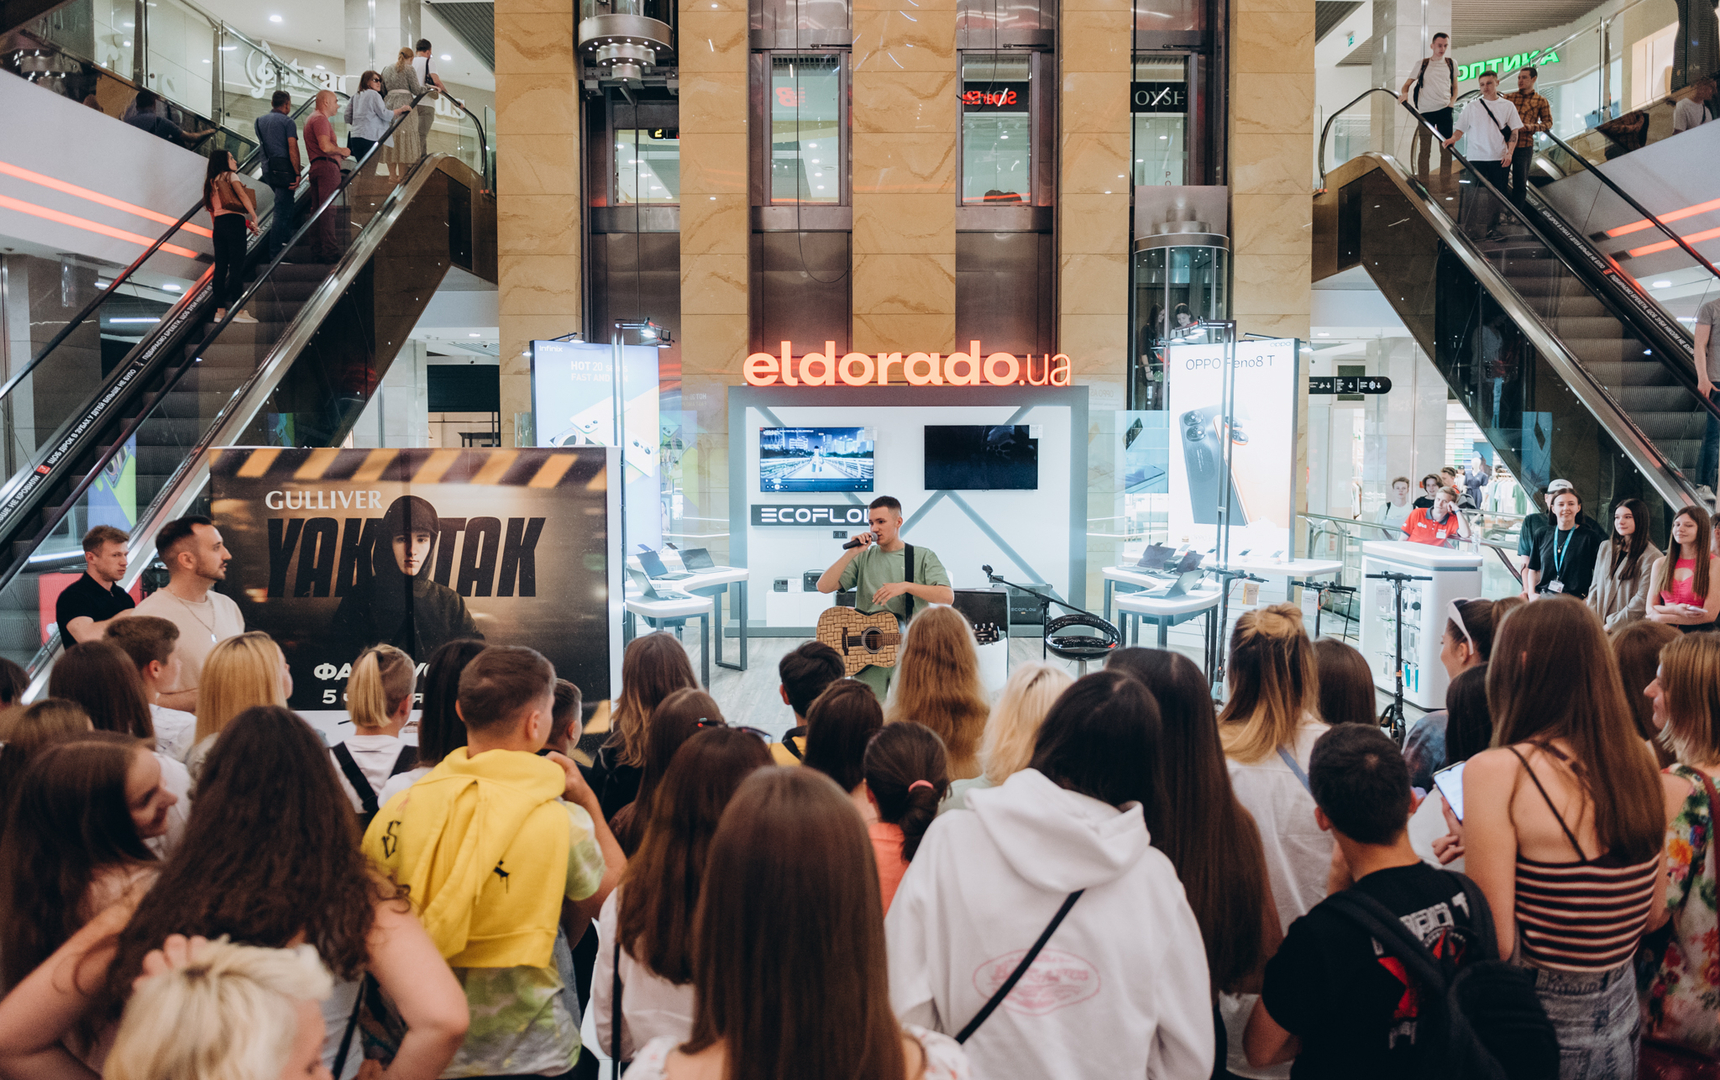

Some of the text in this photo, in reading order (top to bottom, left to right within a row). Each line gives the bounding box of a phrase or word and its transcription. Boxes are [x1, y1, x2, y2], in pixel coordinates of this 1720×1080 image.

[1457, 47, 1560, 82] ОПТИКА
[570, 360, 590, 370] HOT
[592, 362, 603, 372] 20
[743, 340, 1072, 386] eldorado.ua
[1186, 358, 1221, 370] OPPO
[1266, 354, 1276, 366] T
[571, 373, 592, 381] FAST
[593, 374, 610, 382] AND
[265, 490, 382, 510] GULLIVER
[322, 689, 337, 704] 5
